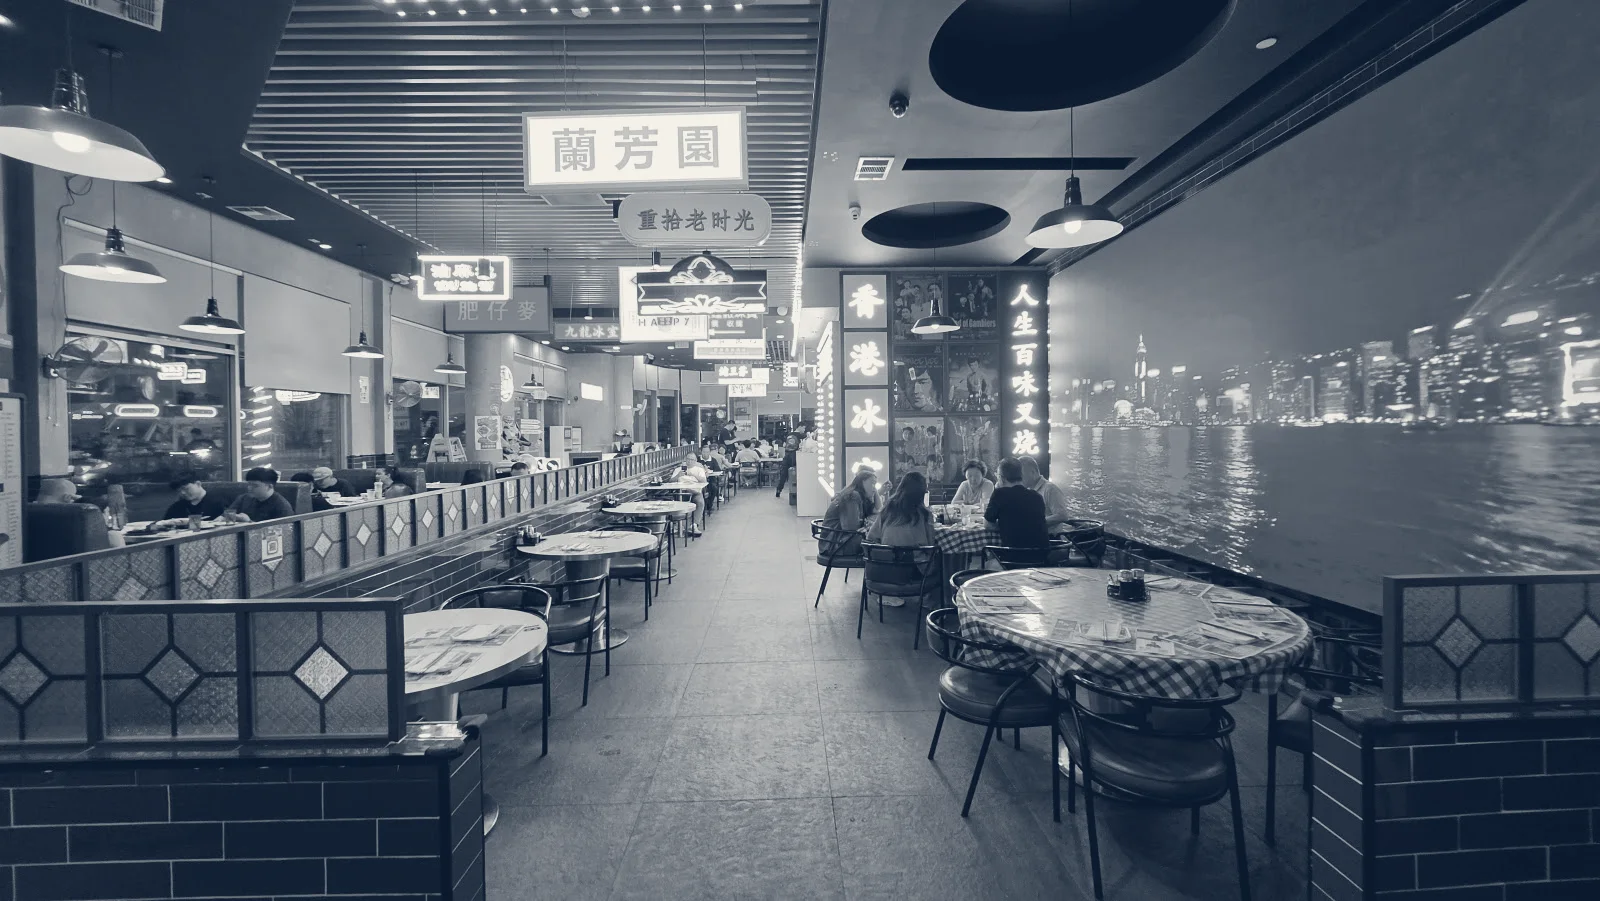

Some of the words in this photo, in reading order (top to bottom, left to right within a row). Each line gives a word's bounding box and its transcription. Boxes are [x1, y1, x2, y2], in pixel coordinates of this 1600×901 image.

[552, 125, 719, 172] 蘭芳園
[636, 208, 755, 232] 重拾老时光
[457, 300, 537, 321] 肥仔麥
[564, 324, 619, 338] 九龍冰室
[638, 317, 690, 327] HAPY
